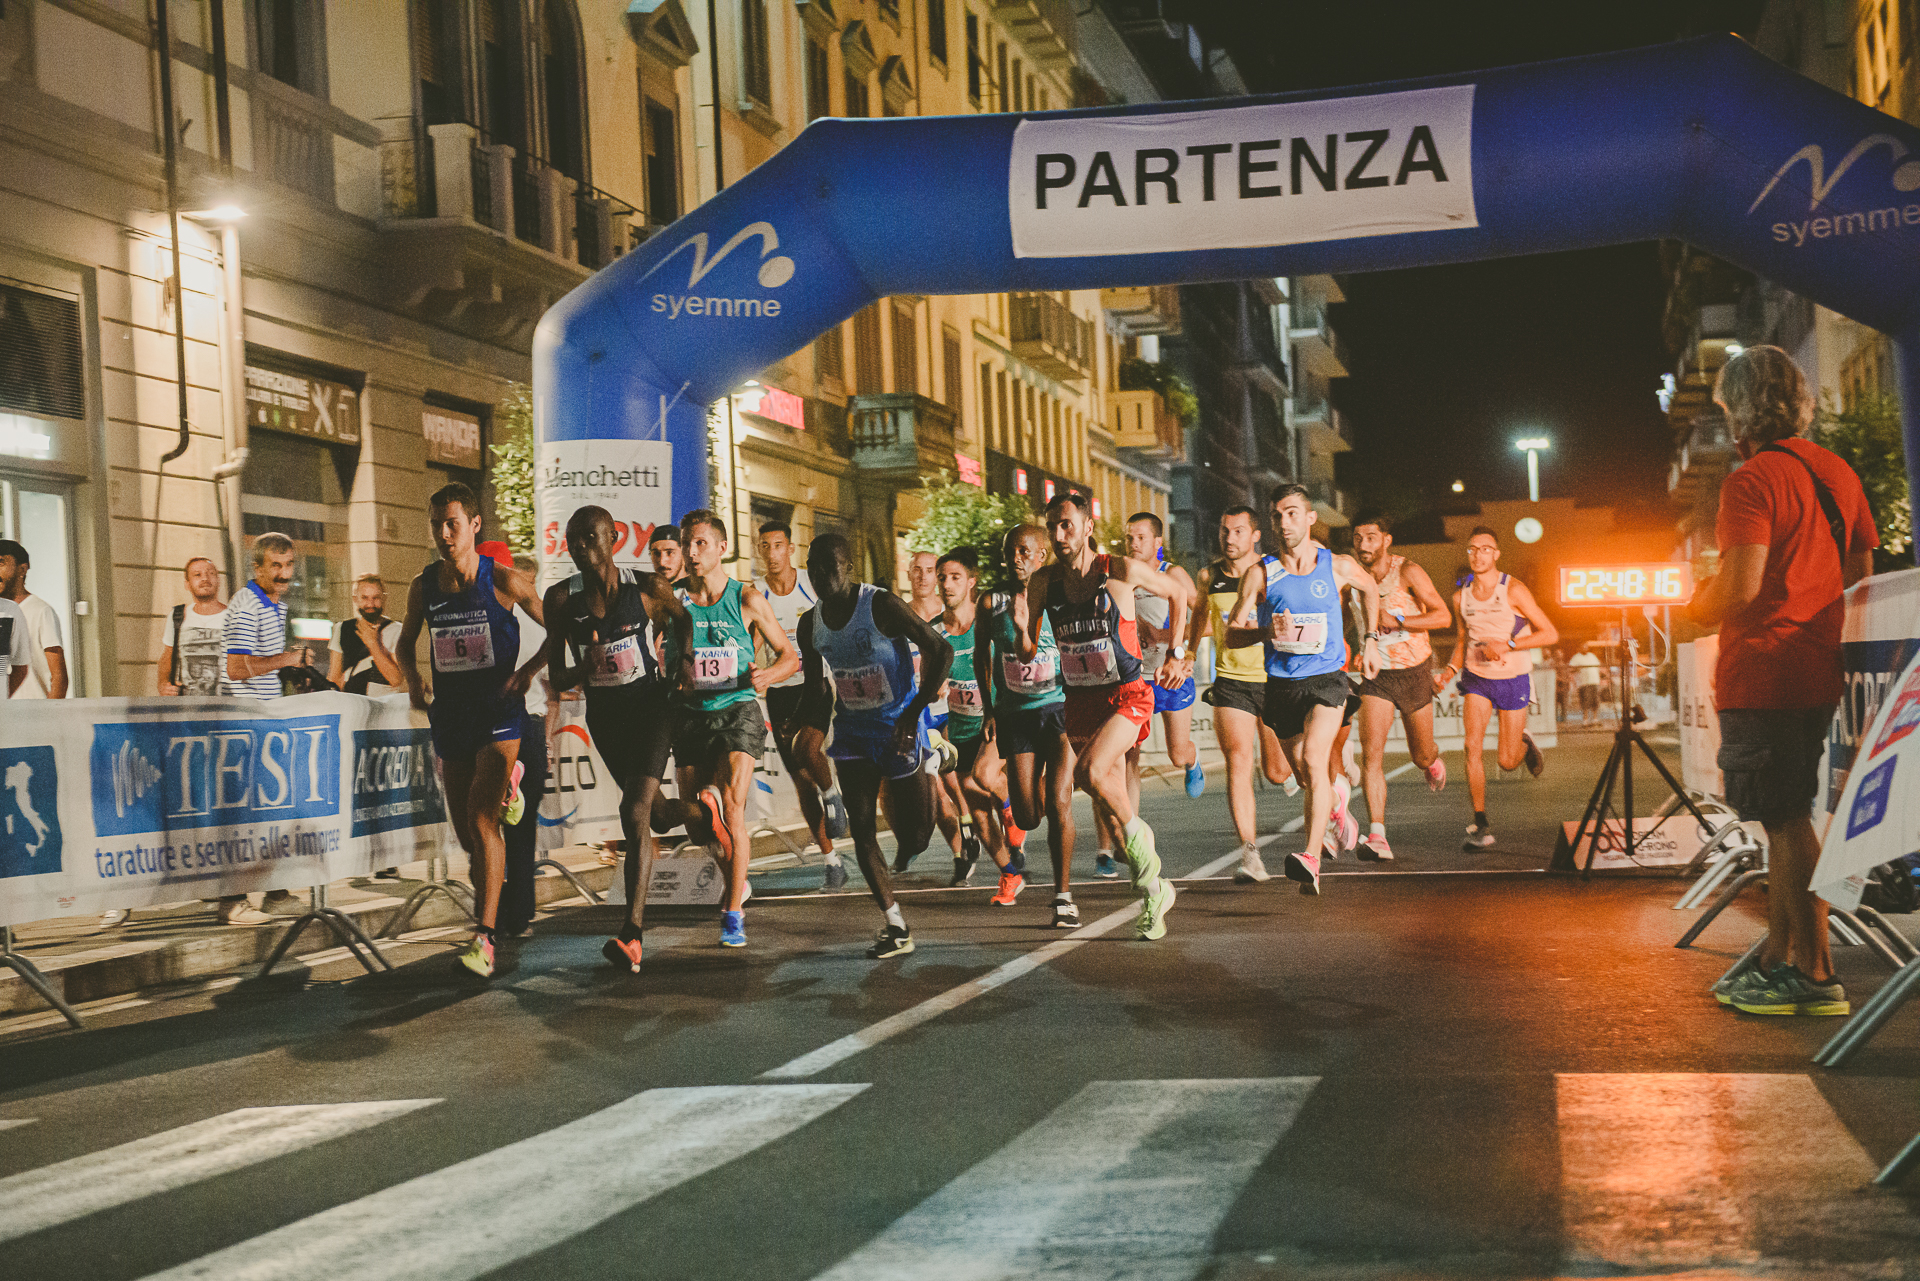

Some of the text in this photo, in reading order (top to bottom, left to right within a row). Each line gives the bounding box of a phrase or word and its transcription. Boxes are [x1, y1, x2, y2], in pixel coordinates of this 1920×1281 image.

[1035, 125, 1449, 210] PARTENZA
[1771, 204, 1920, 247] syemme
[651, 293, 781, 320] syemme
[1567, 570, 1681, 599] 22:48:16
[433, 609, 488, 621] AERONAUTICA
[1292, 616, 1323, 624] KARHU
[451, 626, 486, 637] KARHU
[1295, 626, 1304, 641] 7
[455, 638, 467, 658] 6
[606, 638, 633, 656] ARHU
[701, 650, 733, 658] KARHU
[1072, 641, 1107, 655] KARHU
[605, 656, 618, 674] 5
[699, 660, 720, 677] 13
[1079, 655, 1088, 673] 1
[1022, 666, 1033, 682] 2
[853, 680, 865, 698] 3
[957, 691, 975, 706] 12
[166, 728, 328, 813] TESI
[95, 823, 341, 879] tarature e servizi alle imprese
